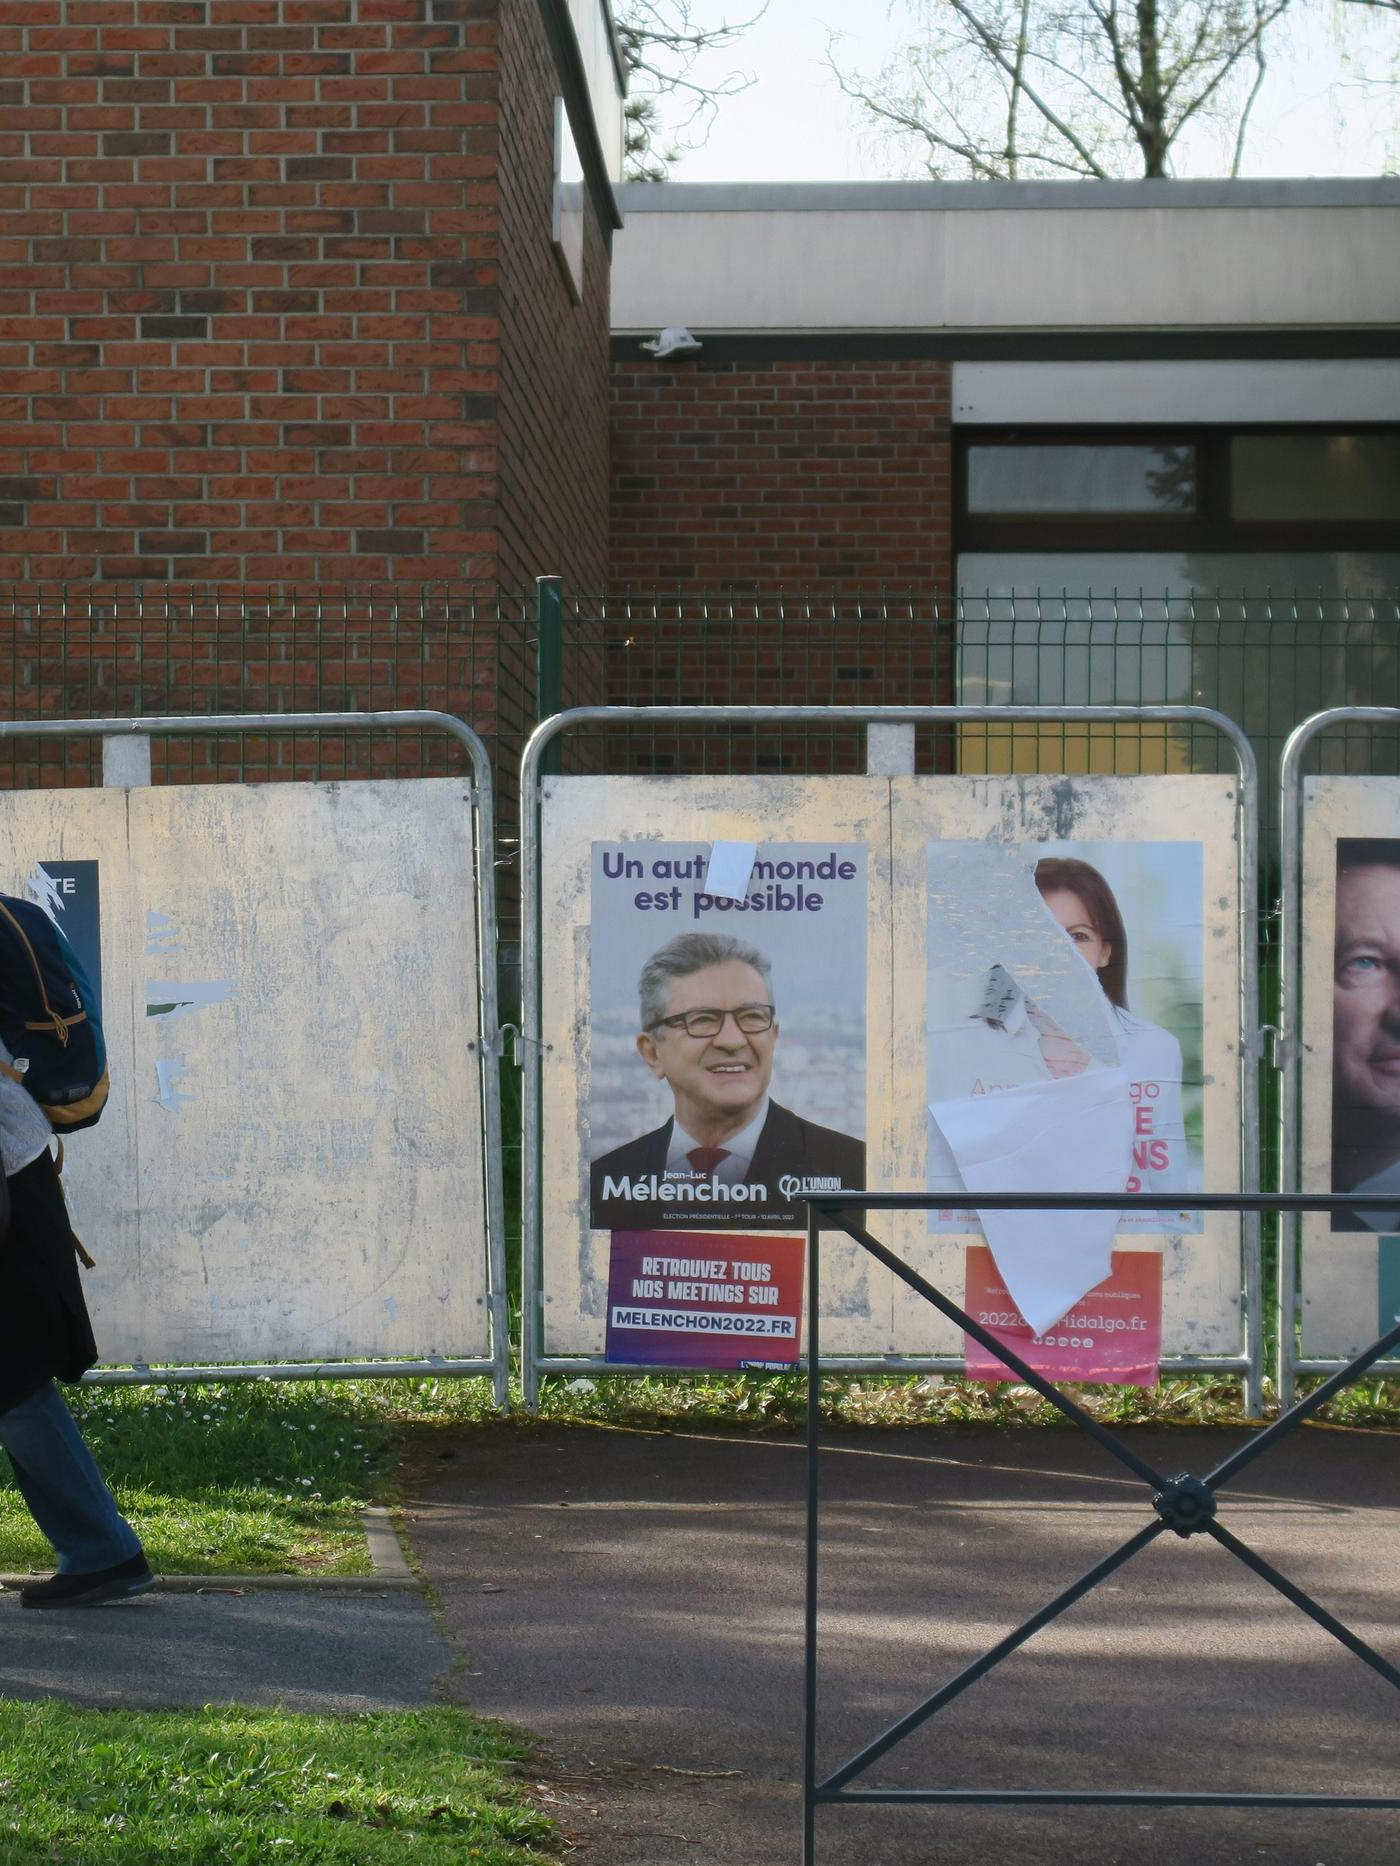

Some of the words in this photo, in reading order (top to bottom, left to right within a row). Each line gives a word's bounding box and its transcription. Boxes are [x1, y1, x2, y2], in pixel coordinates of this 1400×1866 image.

[602, 852, 644, 879] Un
[652, 854, 709, 880] aut
[750, 852, 857, 880] monde
[634, 886, 682, 911] est
[694, 884, 824, 919] possible
[663, 1170, 707, 1181] Jean-Luc
[602, 1175, 768, 1202] Mélenchon
[802, 1176, 841, 1190] L'UNION
[642, 1256, 727, 1280] RETROUVEZ
[731, 1261, 771, 1281] TOUS
[632, 1279, 664, 1298] NOS
[667, 1281, 744, 1303] MEETINGS
[749, 1286, 779, 1305] SUR
[616, 1311, 792, 1334] MELENCHON2022.FR
[978, 1311, 1148, 1333] 2022Hidalgo.fr
